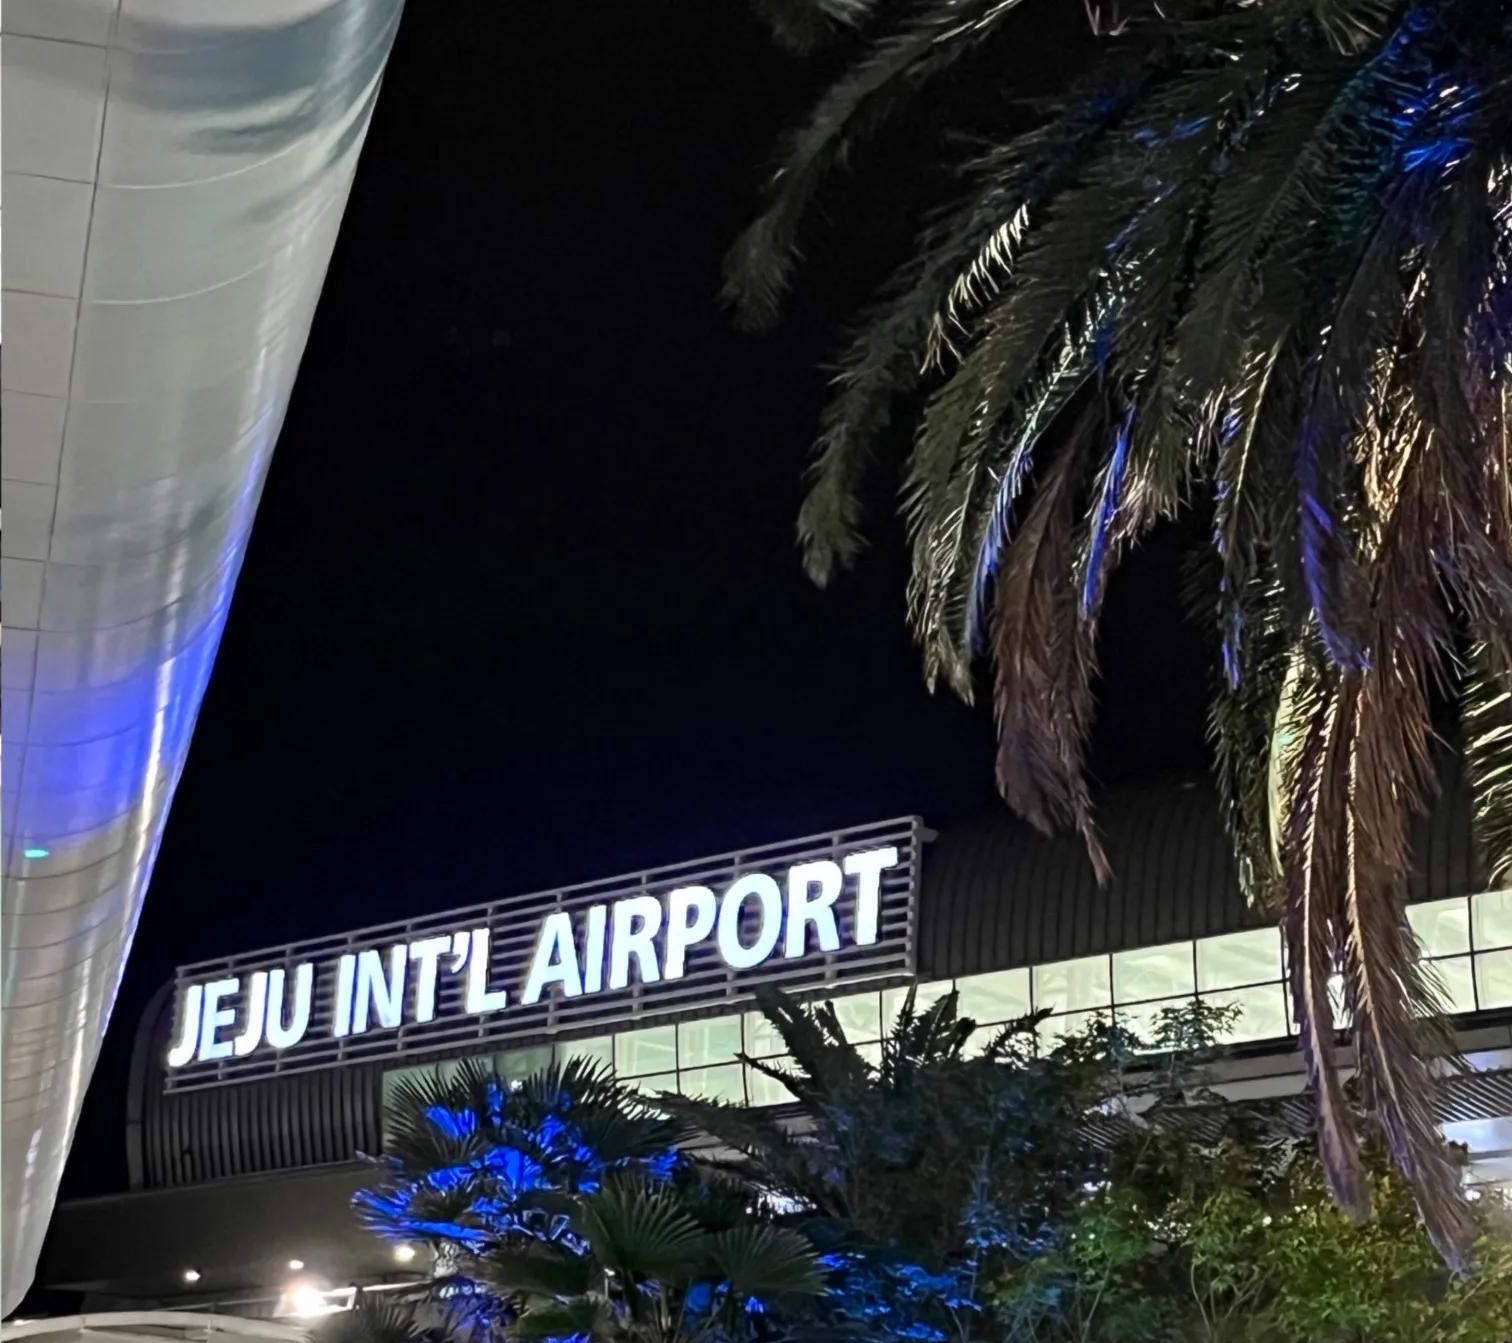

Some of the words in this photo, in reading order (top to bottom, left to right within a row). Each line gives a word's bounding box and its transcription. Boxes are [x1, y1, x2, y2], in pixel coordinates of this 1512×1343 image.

[167, 963, 314, 1068] JEJU
[334, 926, 506, 1037] INT'L
[522, 846, 898, 1005] AIRPORT
